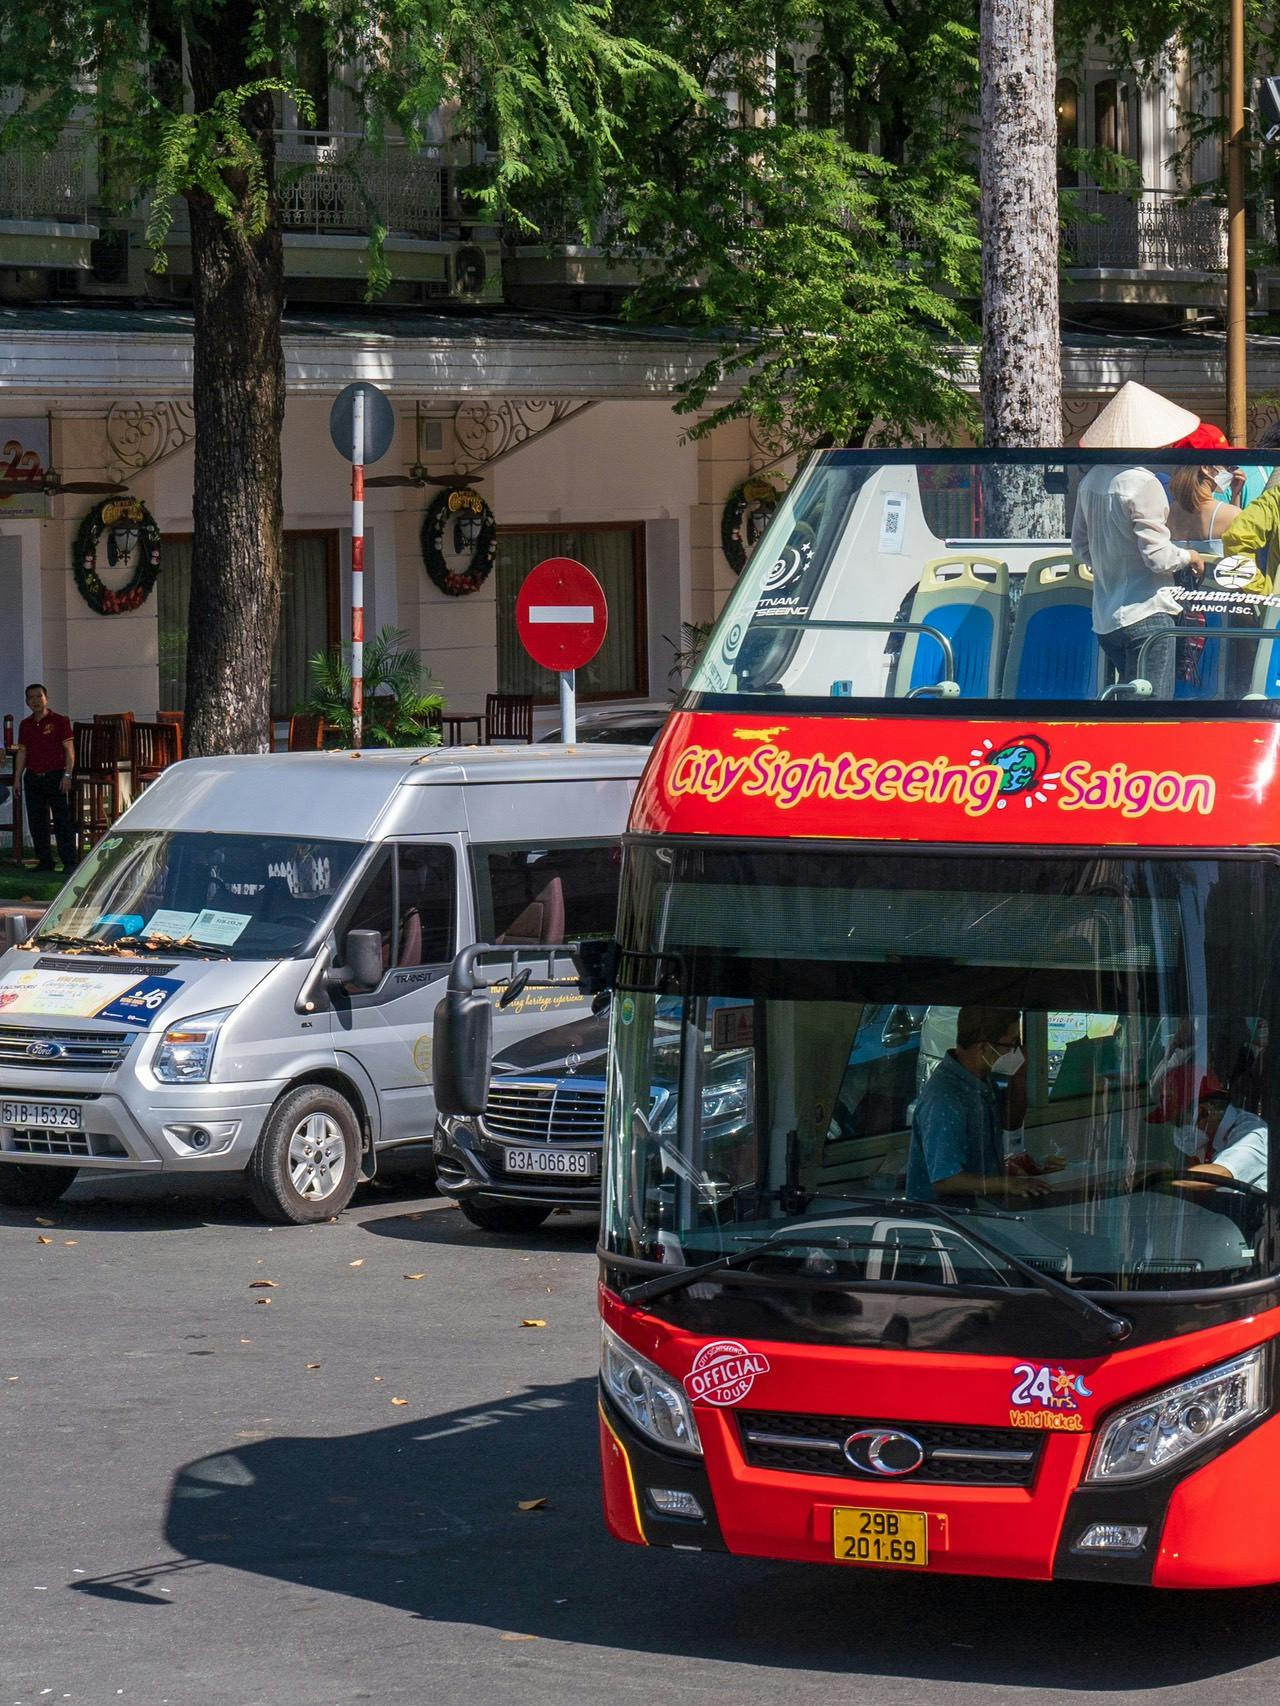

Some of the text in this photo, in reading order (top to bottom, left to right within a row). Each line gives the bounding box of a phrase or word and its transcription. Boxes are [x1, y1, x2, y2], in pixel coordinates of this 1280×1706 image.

[1191, 604, 1254, 615] HANOI JSC.
[1058, 760, 1216, 818] Saigon
[394, 973, 432, 983] TRANSIT
[32, 1043, 53, 1056] Ford
[5, 1103, 78, 1125] 51B-153.29
[508, 1151, 586, 1173] 63A-066.89
[698, 1345, 742, 1368] CITY SIGHTSEEING
[692, 1357, 764, 1394] OFFICIAL
[1011, 1365, 1053, 1405] 24
[717, 1380, 749, 1401] TOUR
[1009, 1410, 1083, 1431] Valid Ticket
[860, 1513, 899, 1536] 29B
[844, 1536, 916, 1562] 201.69
